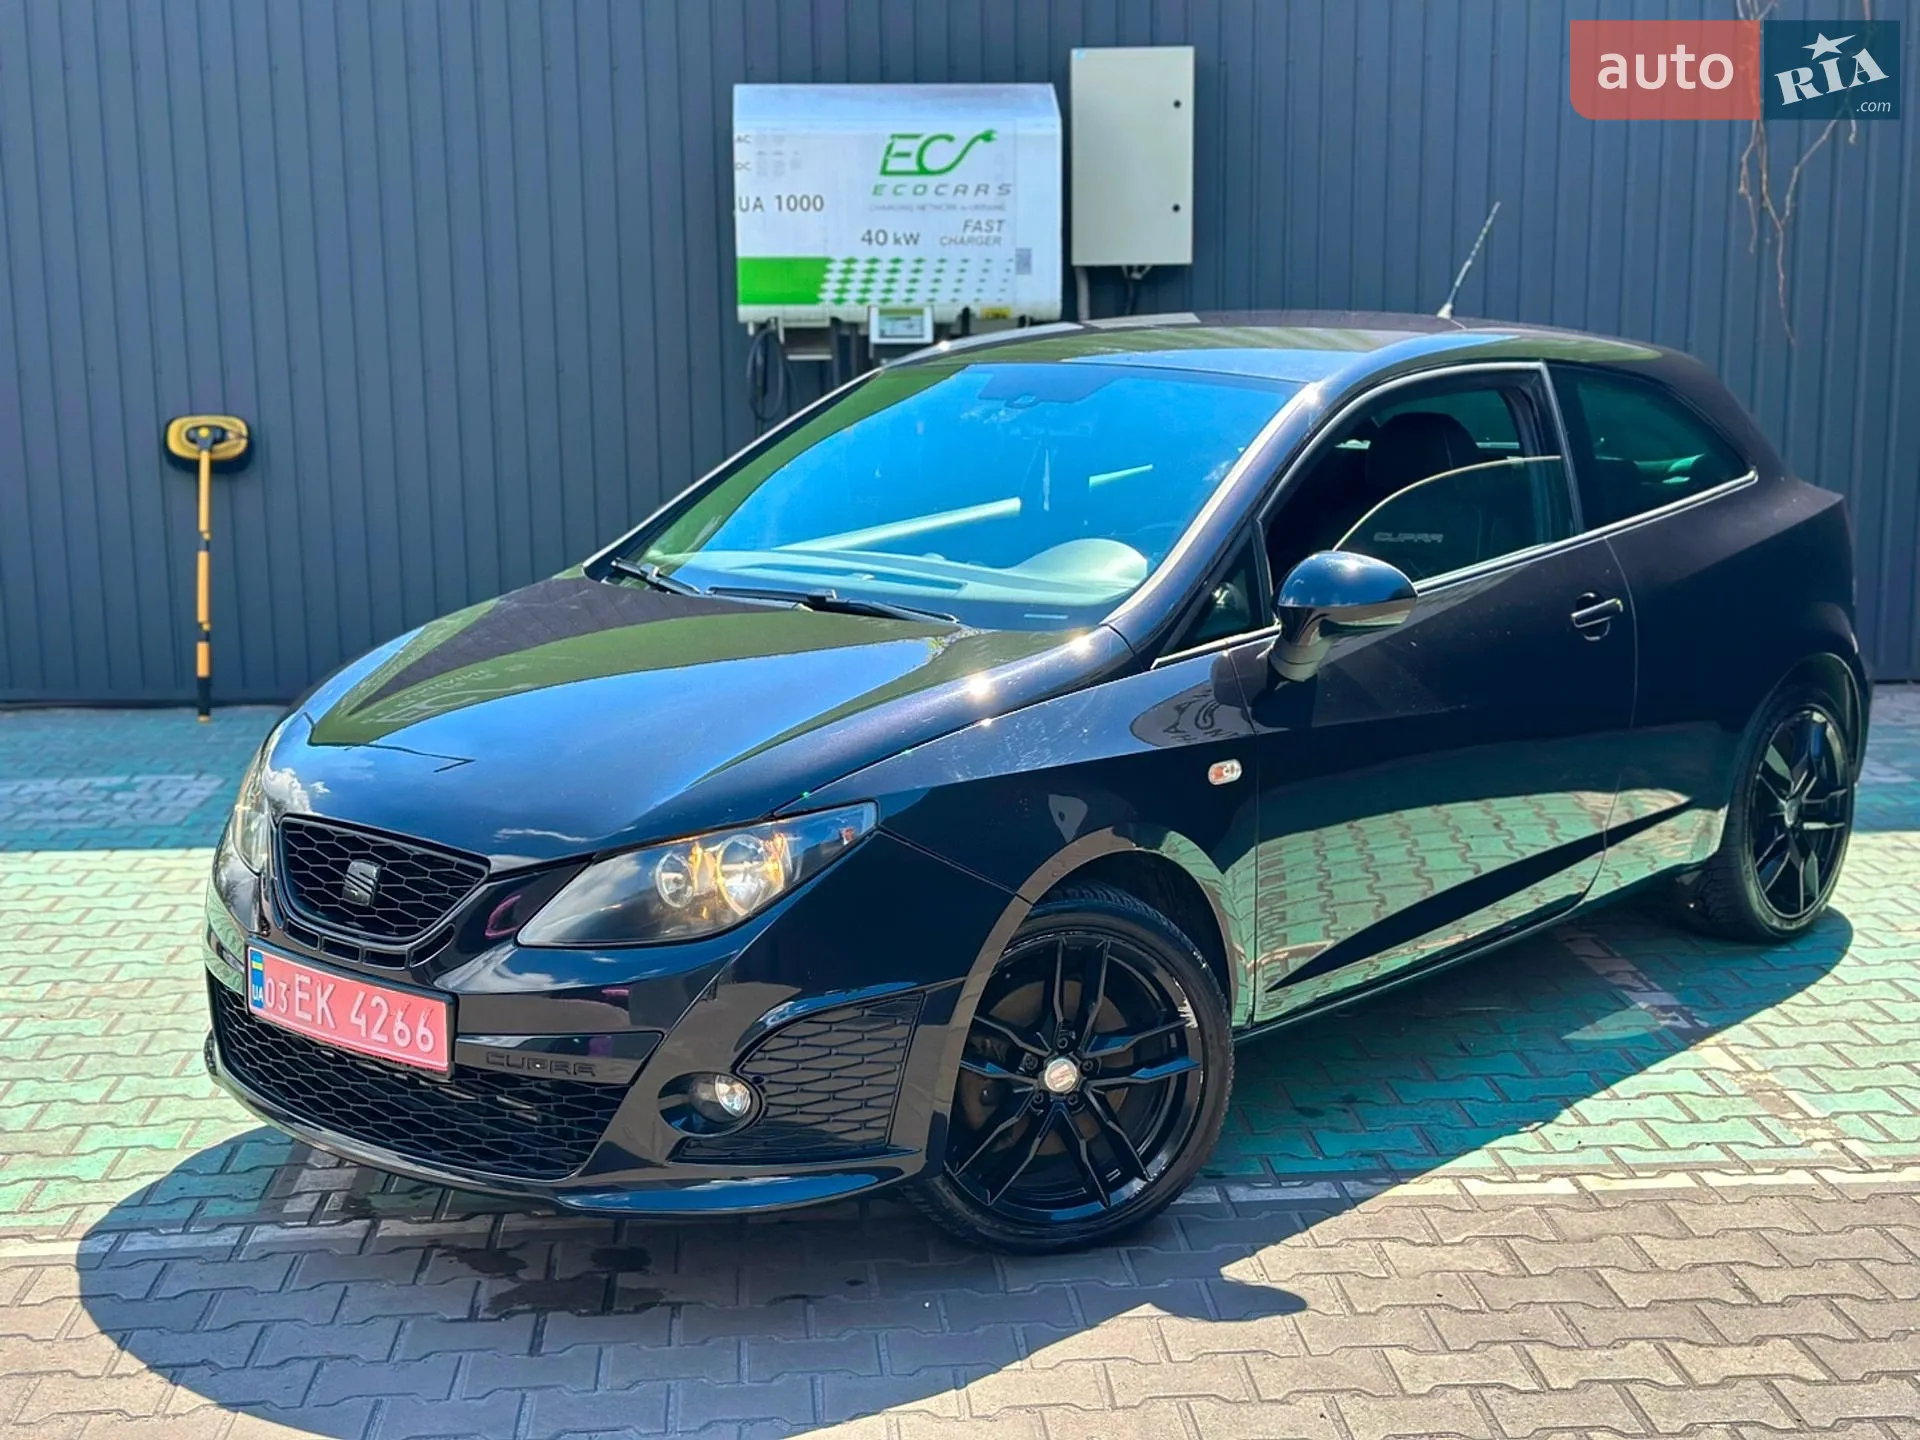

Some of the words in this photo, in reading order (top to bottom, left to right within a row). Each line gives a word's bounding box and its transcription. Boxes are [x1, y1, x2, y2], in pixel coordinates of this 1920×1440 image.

[872, 183, 1012, 197] ECOCARS
[739, 195, 765, 213] UA
[774, 193, 825, 213] 1000
[962, 218, 1005, 234] FAST
[861, 228, 888, 247] 40
[939, 235, 1002, 247] CHARGER
[252, 983, 264, 1003] UA
[350, 990, 435, 1054] 4266
[486, 1051, 596, 1078] CUPRA
